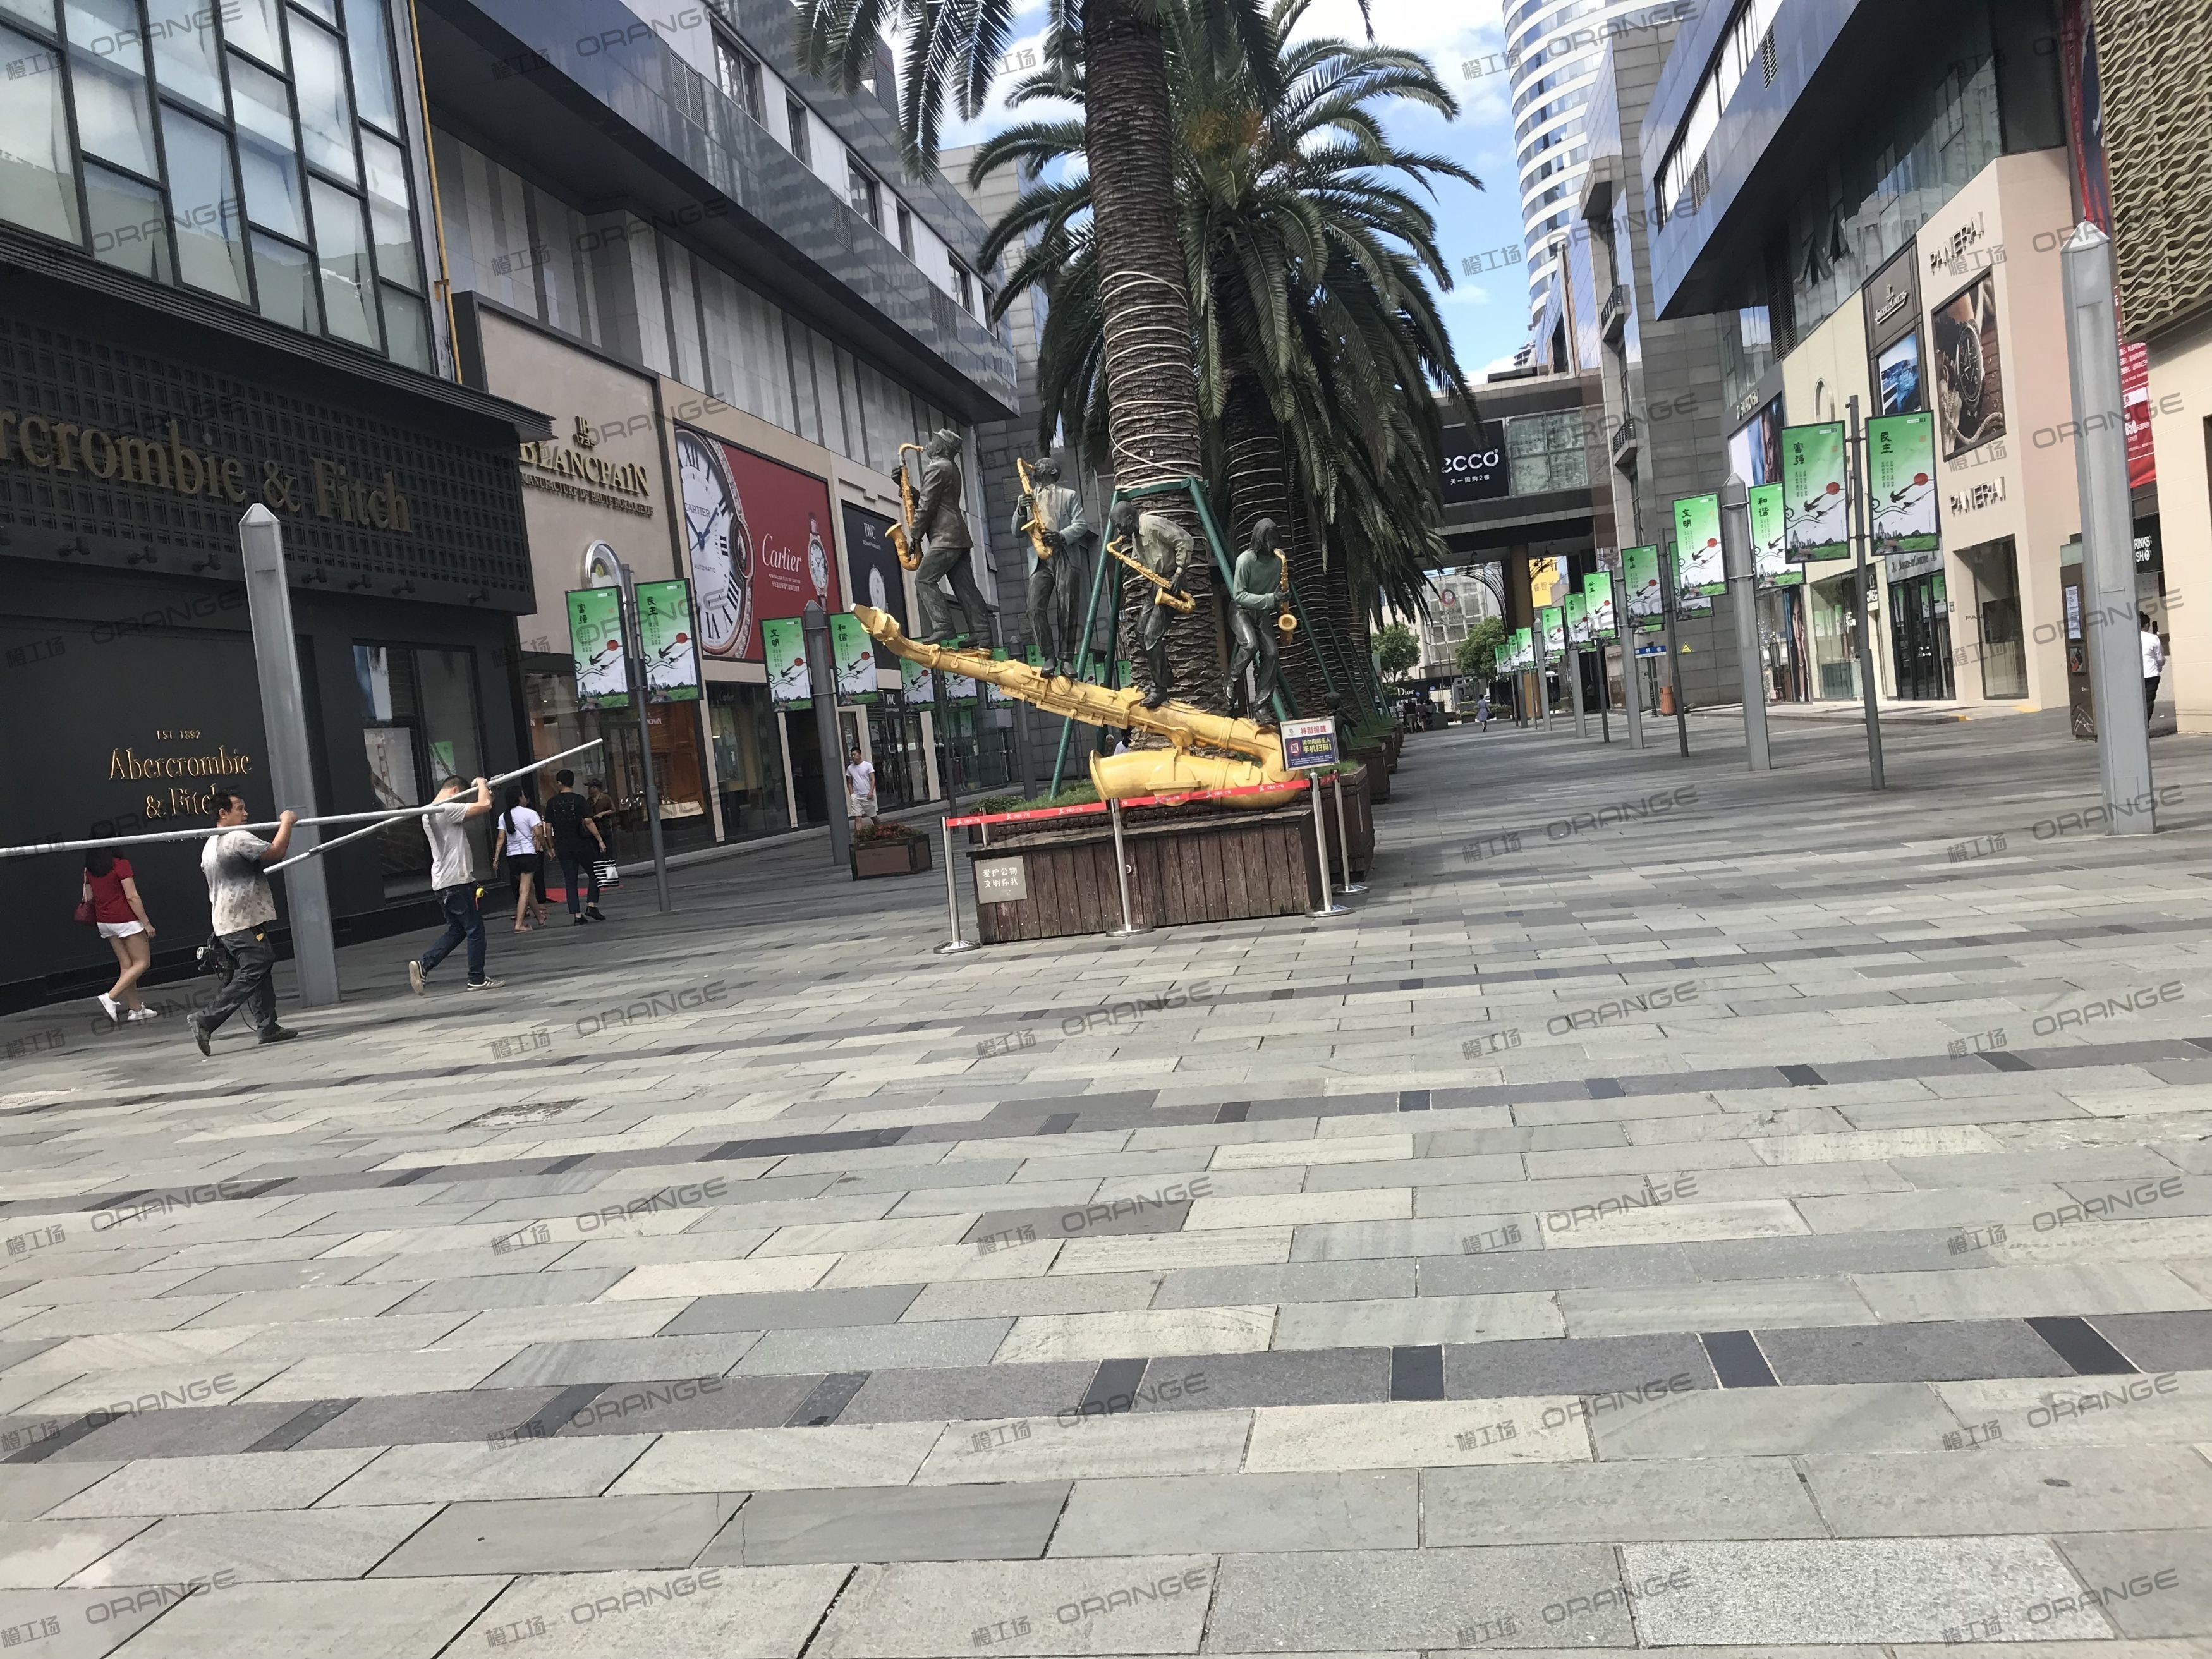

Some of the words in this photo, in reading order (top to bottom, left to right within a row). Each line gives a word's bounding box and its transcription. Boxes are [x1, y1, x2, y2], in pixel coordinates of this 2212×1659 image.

[1929, 212, 1984, 274] PANERAI
[1880, 432, 1893, 454] 民主
[1793, 442, 1805, 465] 富强
[521, 473, 578, 495] MANUFACTURE
[1450, 474, 1490, 485] 天一国购2楼
[263, 460, 301, 512] &
[309, 456, 413, 533] Fitch
[1949, 477, 2006, 515] PANERAI
[1758, 497, 1770, 517] 和谐
[1682, 509, 1692, 528] 文明
[863, 522, 876, 540] IWC
[2134, 535, 2150, 550] RINKS
[762, 533, 802, 573] Cartier
[577, 603, 588, 624] 富强
[647, 596, 658, 616] 民主
[770, 629, 781, 647] 文明
[837, 624, 848, 642] 和谐
[886, 693, 896, 705] IWC
[1397, 688, 1414, 696] Dior
[1300, 725, 1327, 735] 特别提醒
[1302, 737, 1331, 746] 请勿向陌生人
[108, 744, 252, 781] Abercrombie
[146, 794, 166, 818] &
[983, 867, 1018, 878] 爱护公物
[983, 877, 1018, 888] 文明你我
